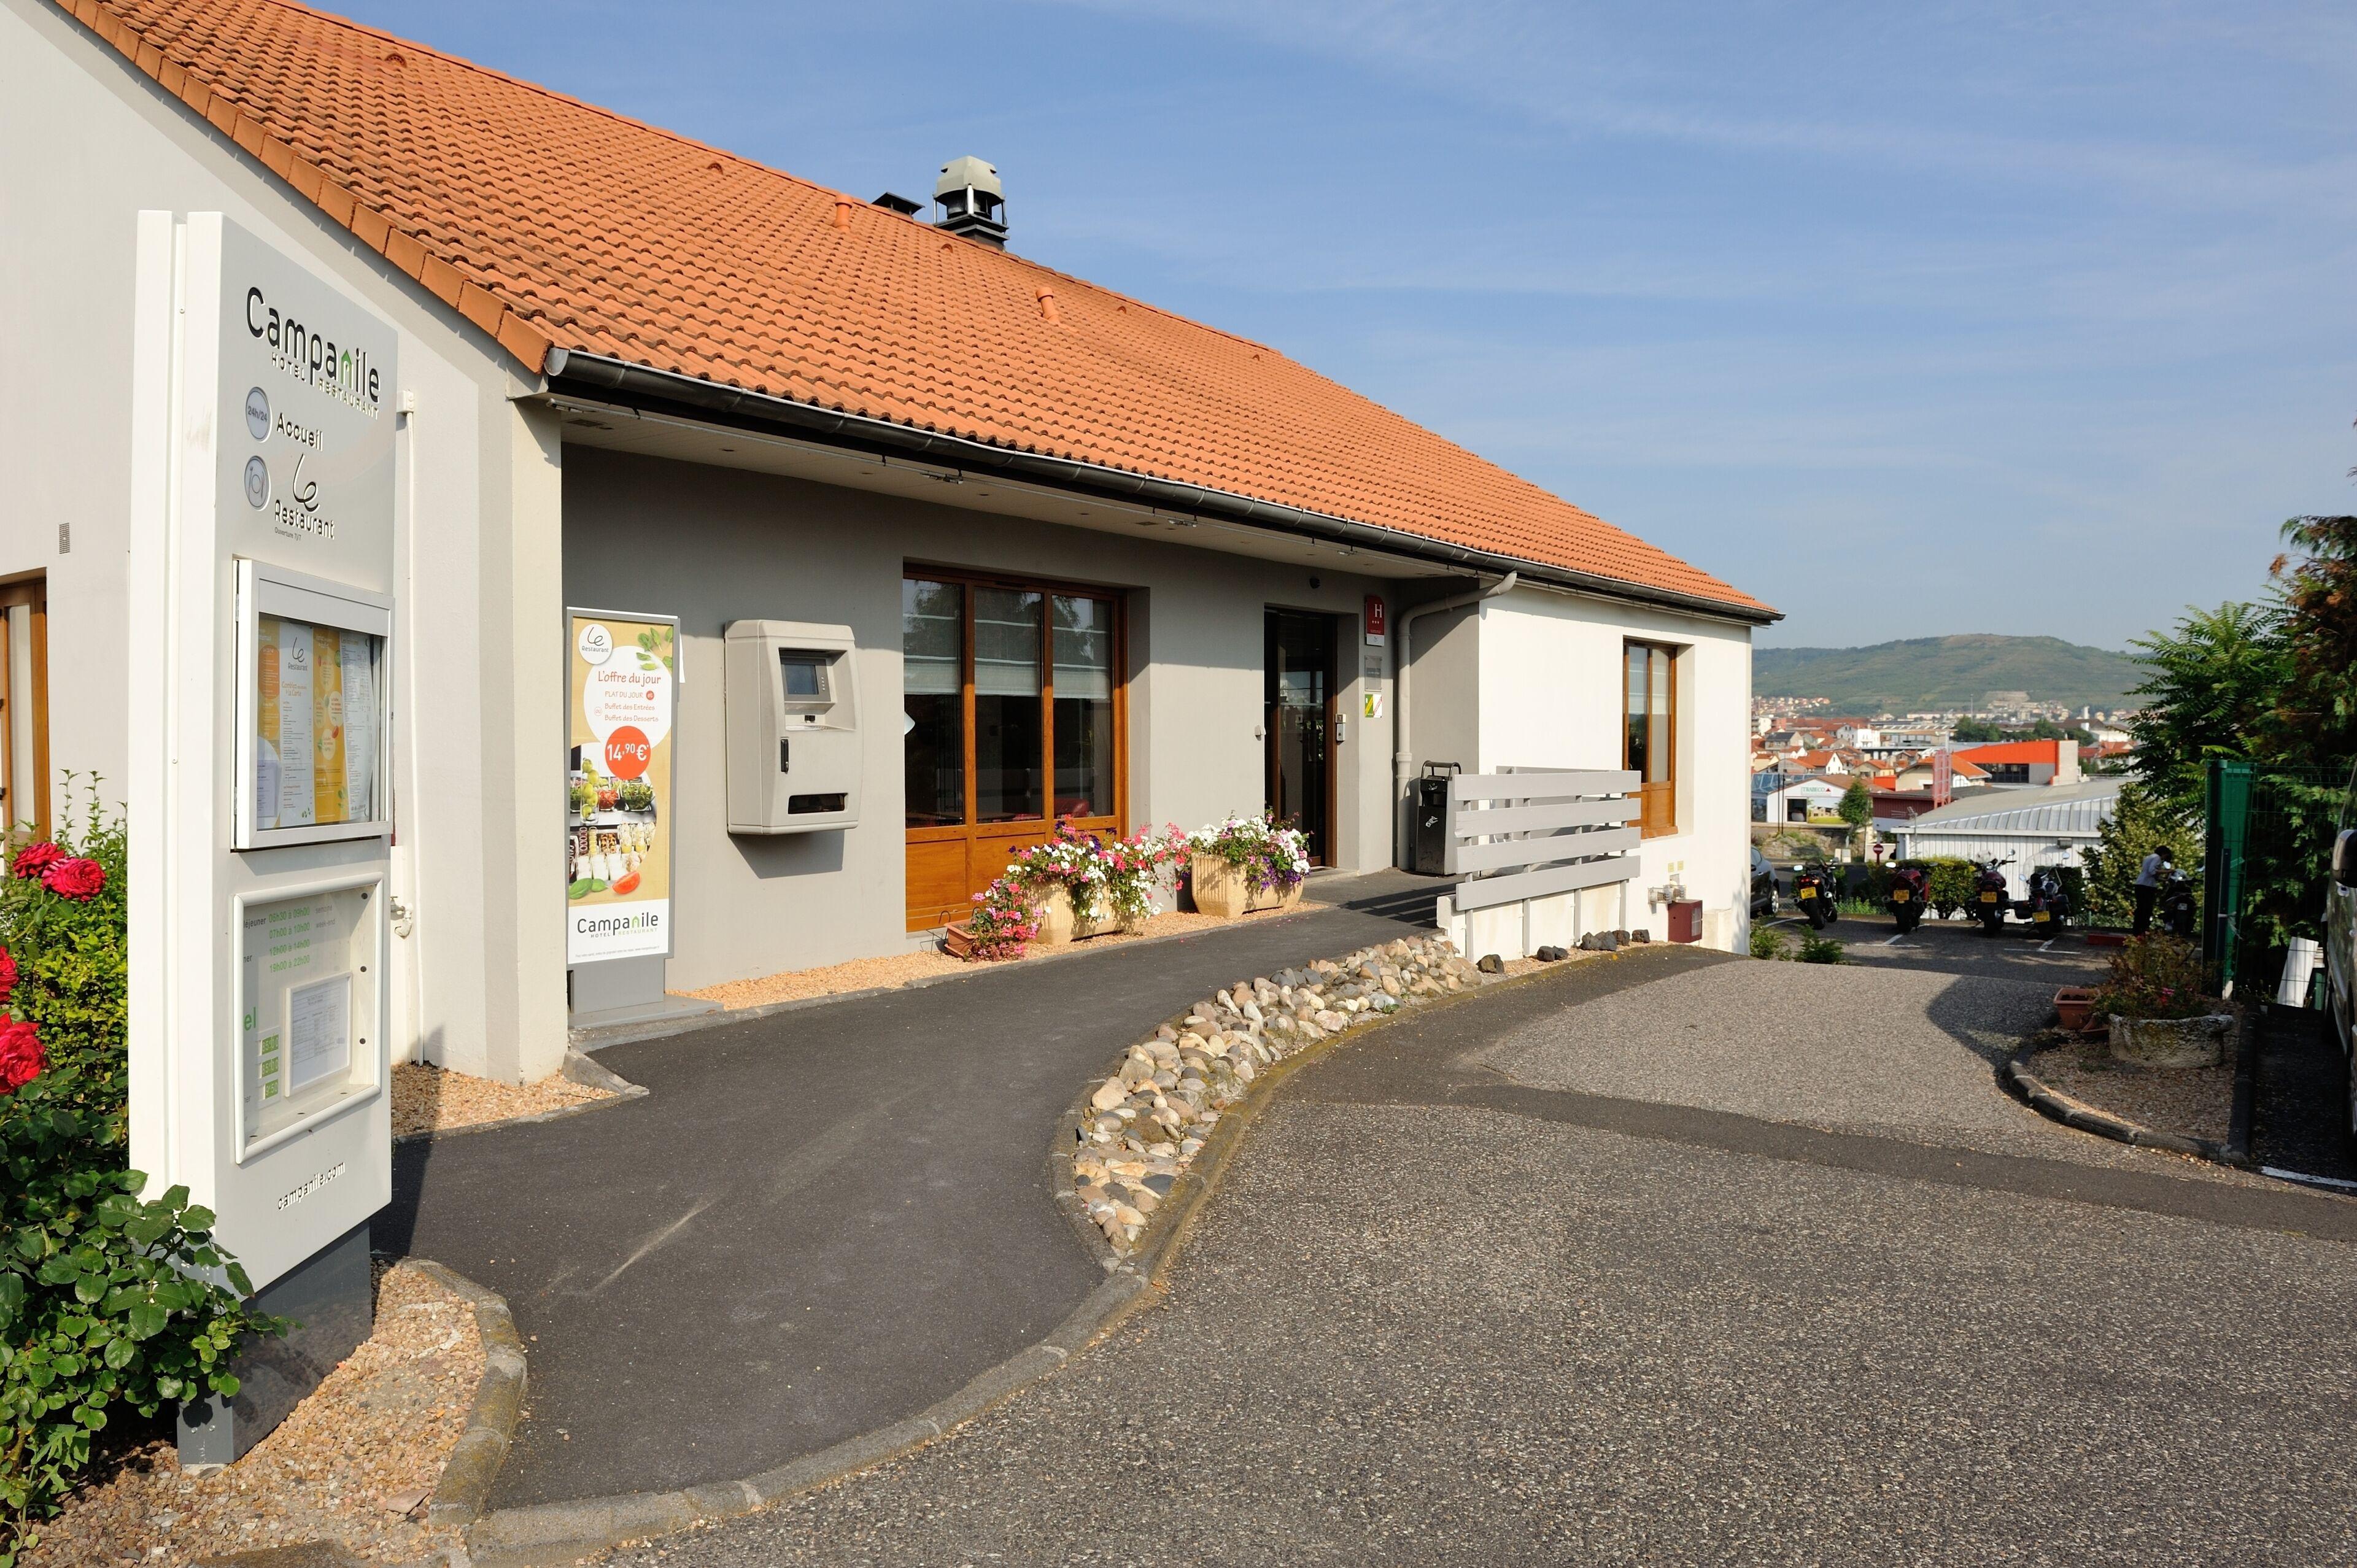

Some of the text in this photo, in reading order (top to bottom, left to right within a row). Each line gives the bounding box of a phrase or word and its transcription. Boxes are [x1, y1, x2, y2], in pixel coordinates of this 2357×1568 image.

[247, 287, 381, 404] Campanile
[272, 352, 379, 420] HOTEL RESTAURANT
[247, 406, 267, 422] 24h/24
[277, 412, 323, 451] Accueil
[274, 500, 335, 540] Restaurant
[1375, 604, 1382, 618] H
[587, 627, 605, 646] Le
[598, 671, 661, 687] L'offre du jour
[293, 907, 310, 918] 09h00
[578, 912, 658, 935] Campanile
[278, 1162, 345, 1211] campanile.com
